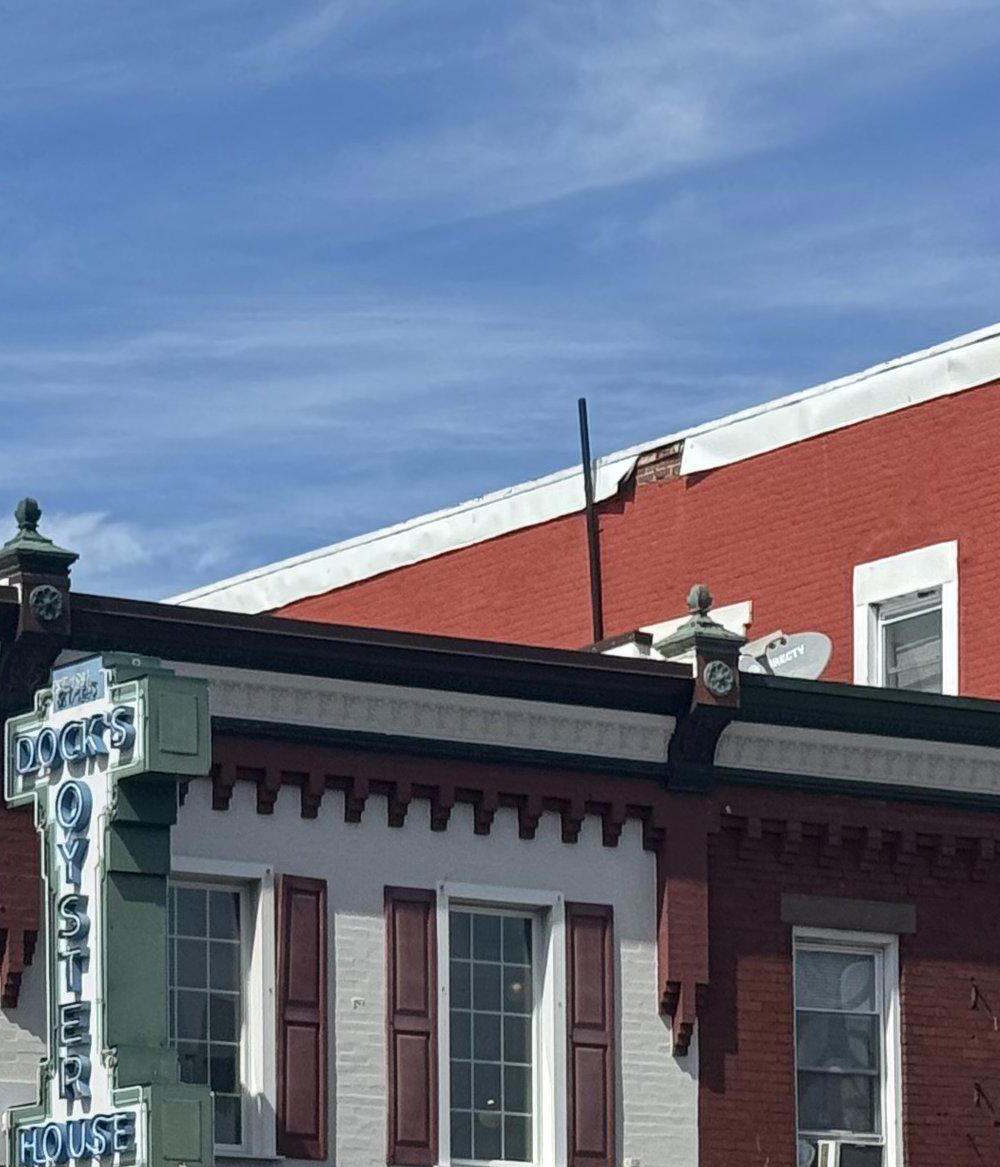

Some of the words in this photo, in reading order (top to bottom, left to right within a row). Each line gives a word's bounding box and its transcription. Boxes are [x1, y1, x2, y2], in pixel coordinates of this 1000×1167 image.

[769, 644, 804, 668] IRECTV
[14, 705, 136, 775] DOCK'S
[56, 780, 93, 1100] OYSTER
